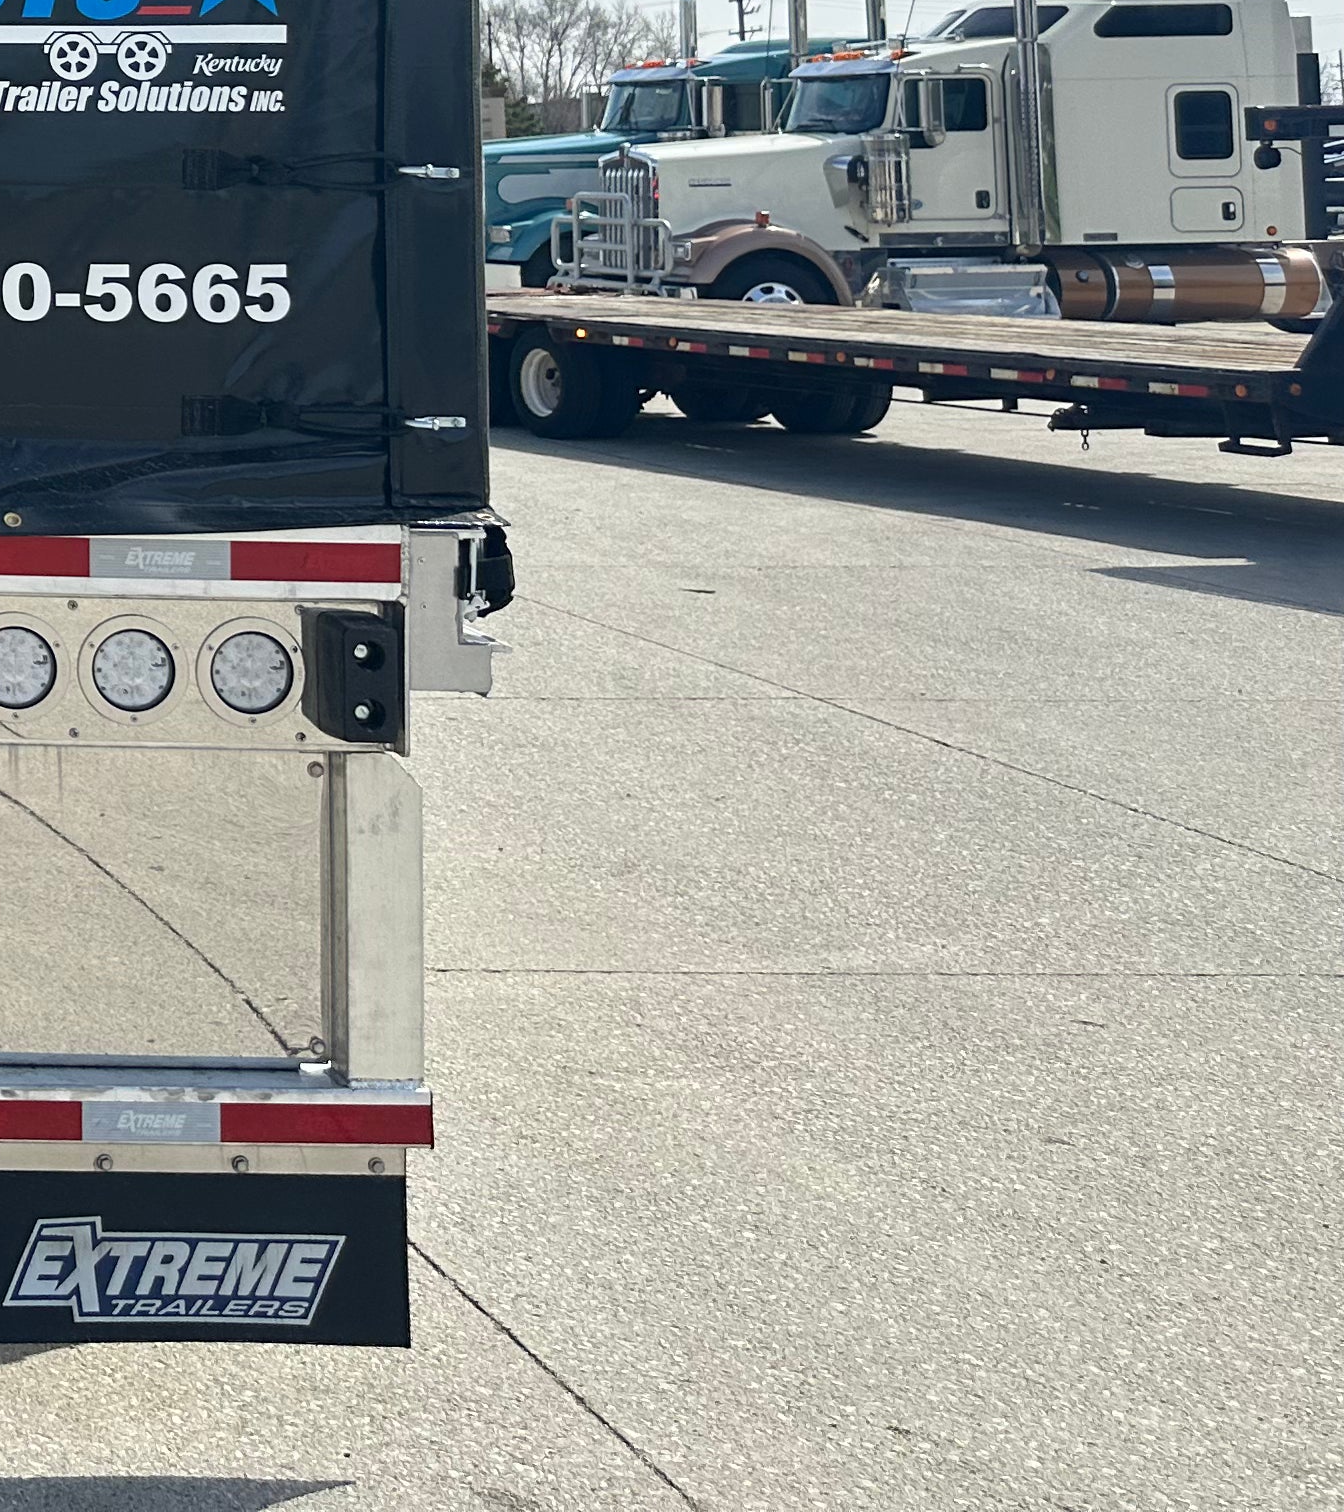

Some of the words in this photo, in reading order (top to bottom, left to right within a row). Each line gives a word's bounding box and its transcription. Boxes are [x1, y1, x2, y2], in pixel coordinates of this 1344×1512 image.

[193, 53, 283, 77] Kentucky
[99, 82, 246, 113] Solutions
[250, 89, 286, 113] INC.
[125, 547, 196, 569] EXTREME
[117, 1110, 186, 1132] EXTREME
[19, 1225, 329, 1312] EXTREME
[112, 1299, 310, 1317] TRAILERS
